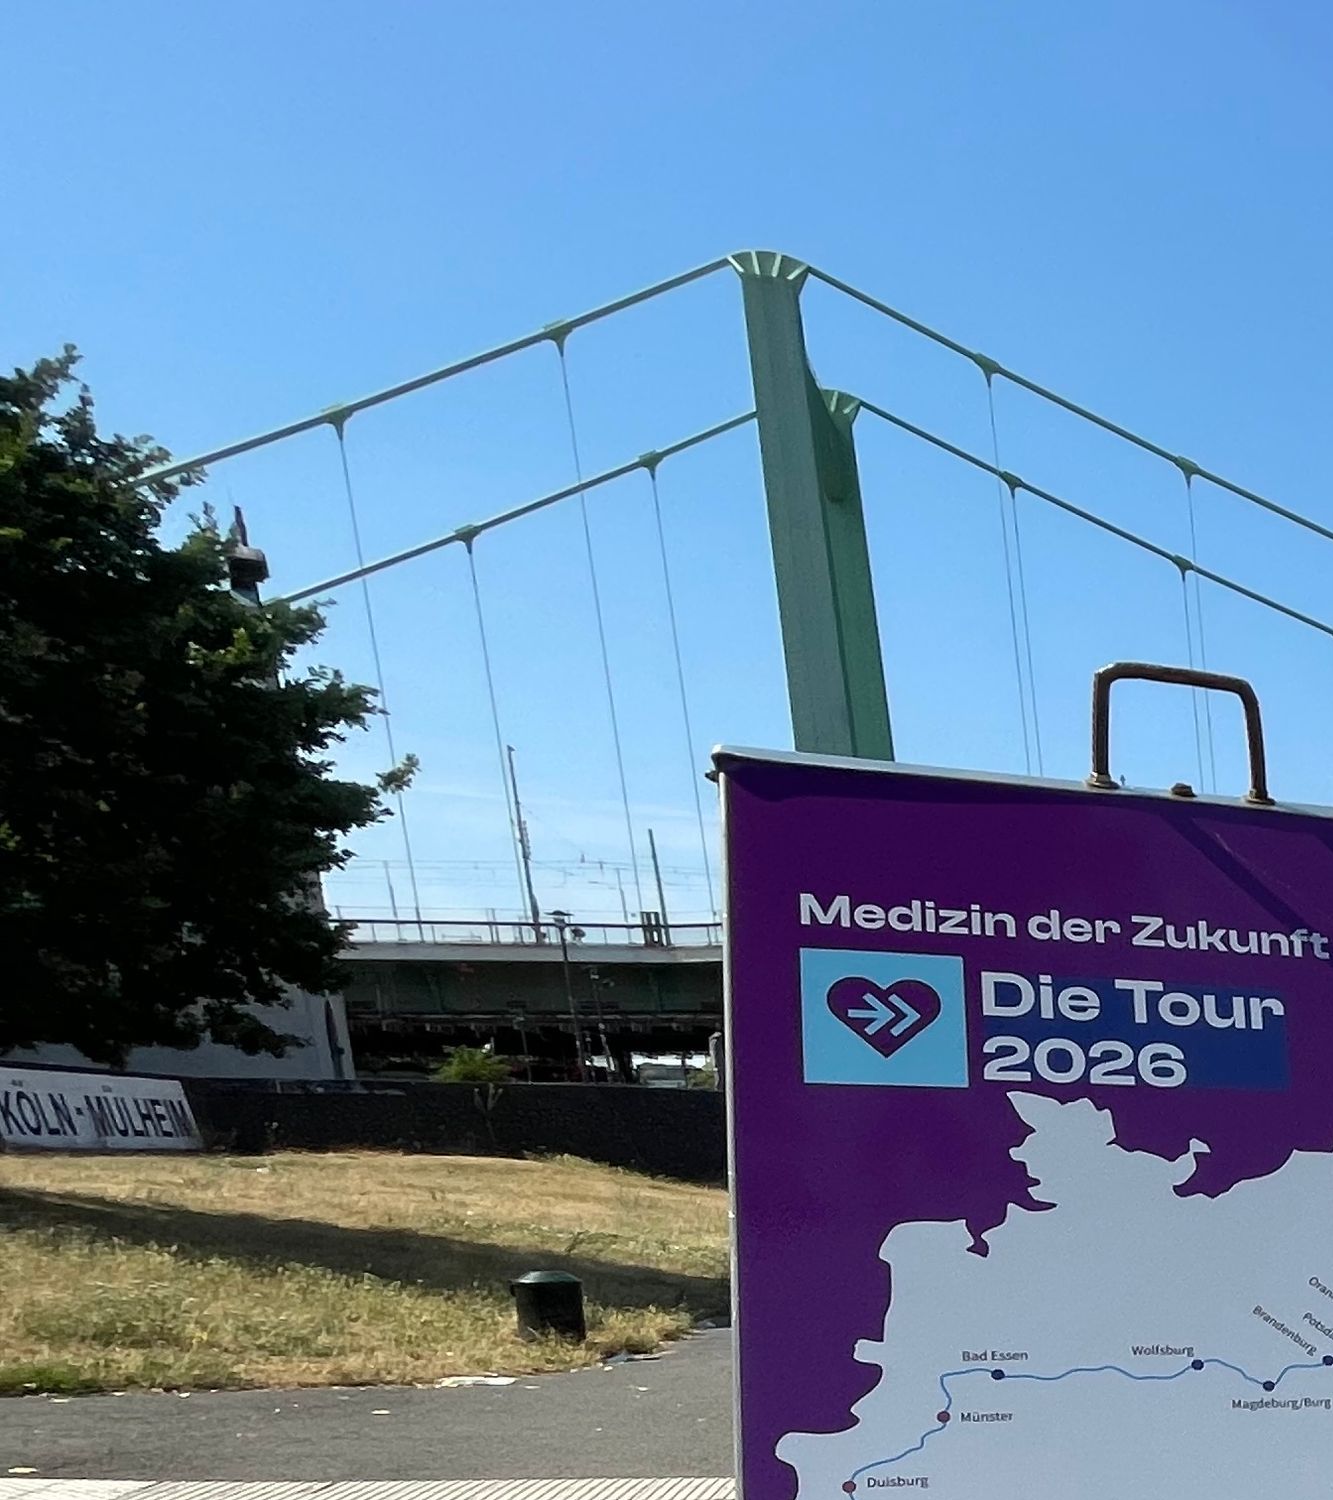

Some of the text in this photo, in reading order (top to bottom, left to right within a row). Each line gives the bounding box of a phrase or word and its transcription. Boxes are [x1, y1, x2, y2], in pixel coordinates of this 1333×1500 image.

[799, 892, 1332, 961] Medizin der Zukunft
[981, 971, 1288, 1031] Die Tour
[981, 1035, 1189, 1086] 2026
[1252, 1305, 1318, 1357] Brandenburg
[961, 1350, 1029, 1362] Bad Essen
[1130, 1344, 1195, 1358] Wolfsburg
[1231, 1395, 1332, 1412] Magdeburg/Burg
[960, 1410, 1014, 1424] Münster
[866, 1475, 929, 1490] Duisburg
